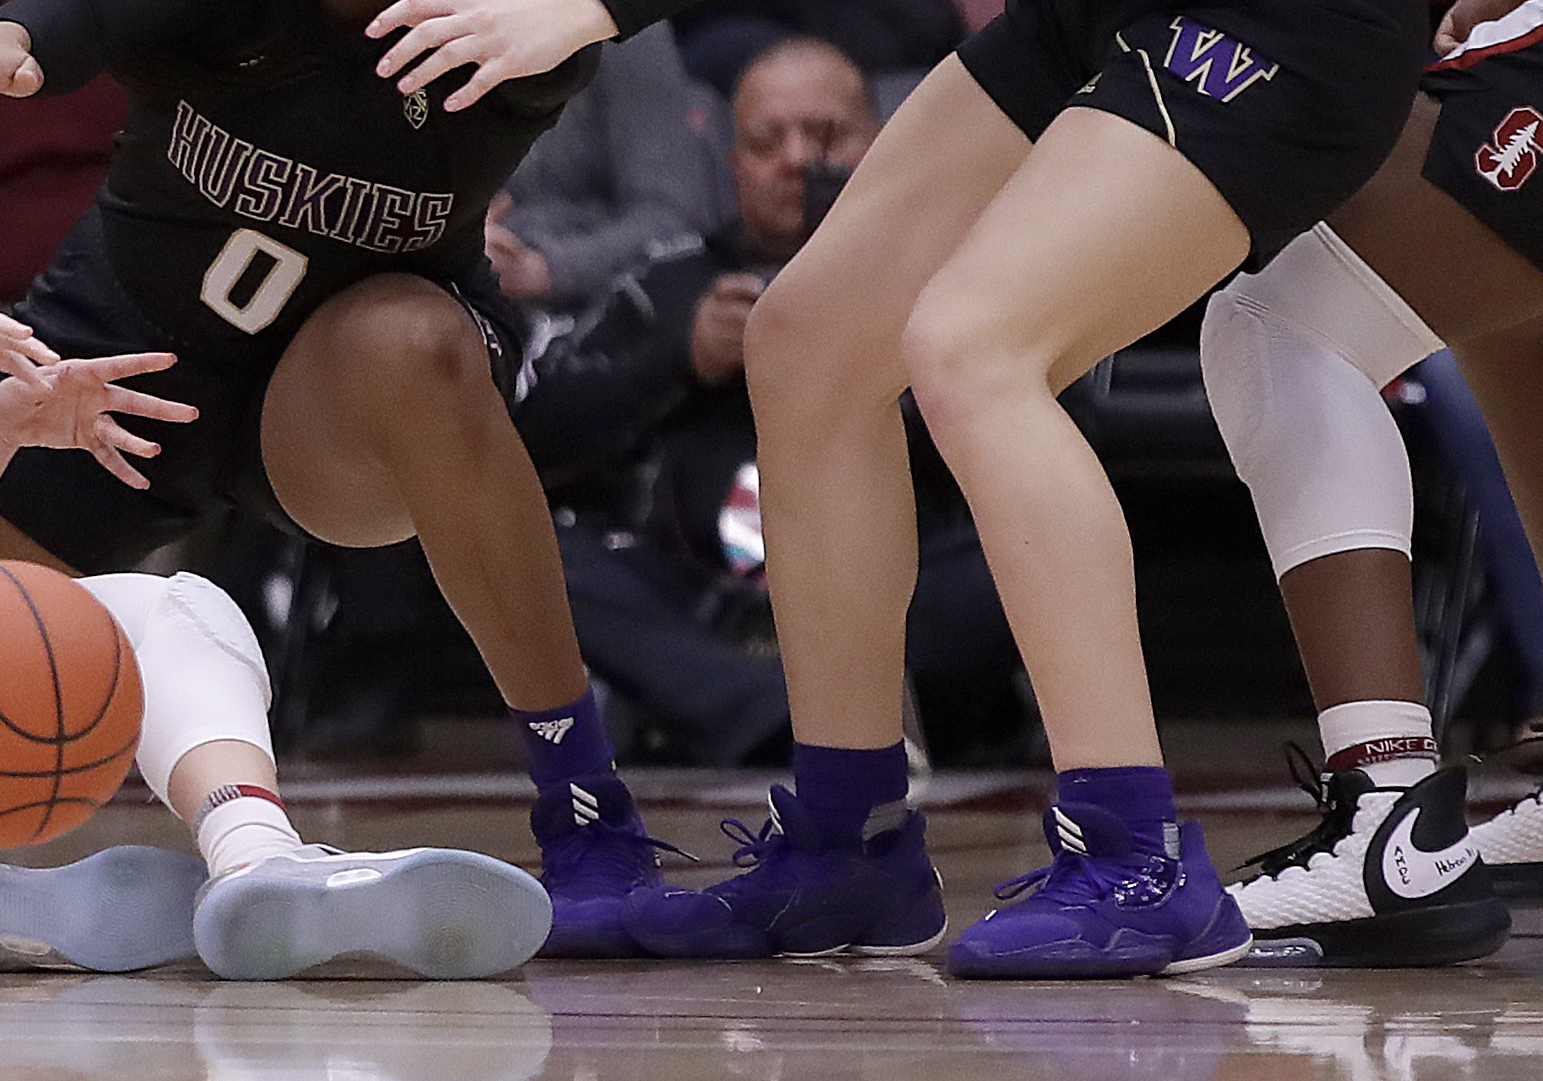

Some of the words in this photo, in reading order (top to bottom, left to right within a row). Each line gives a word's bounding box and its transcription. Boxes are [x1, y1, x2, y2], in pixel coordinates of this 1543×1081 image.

[167, 99, 454, 253] HUSKIES
[200, 228, 309, 335] 0
[1365, 739, 1418, 754] NIKE
